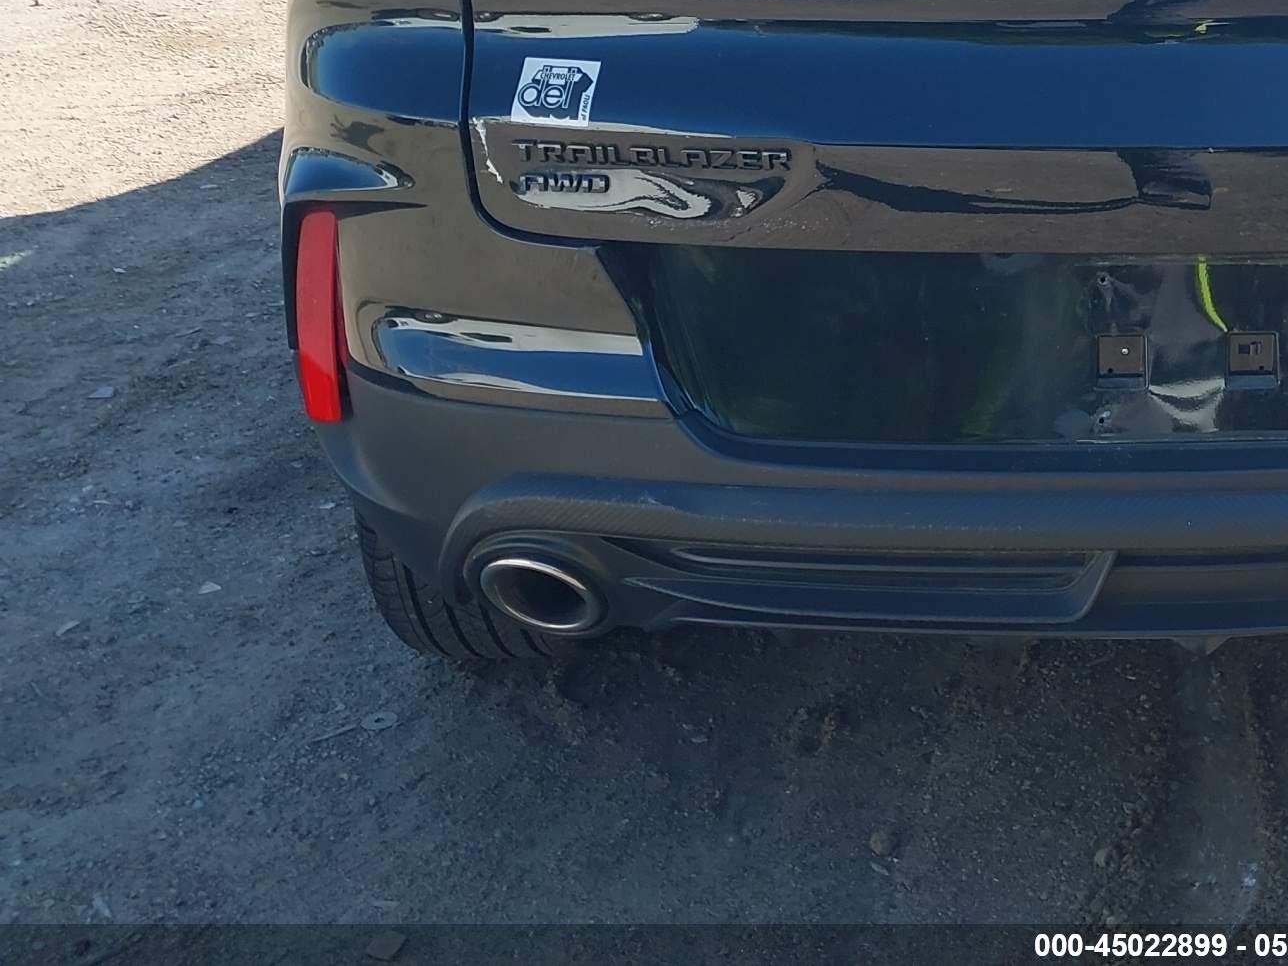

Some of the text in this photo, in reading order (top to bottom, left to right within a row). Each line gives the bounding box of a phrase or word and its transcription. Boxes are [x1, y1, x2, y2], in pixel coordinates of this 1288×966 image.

[518, 66, 578, 109] del
[540, 71, 576, 82] CHEVROLET
[512, 138, 792, 171] TRAILBLAZER
[519, 172, 611, 194] AWD
